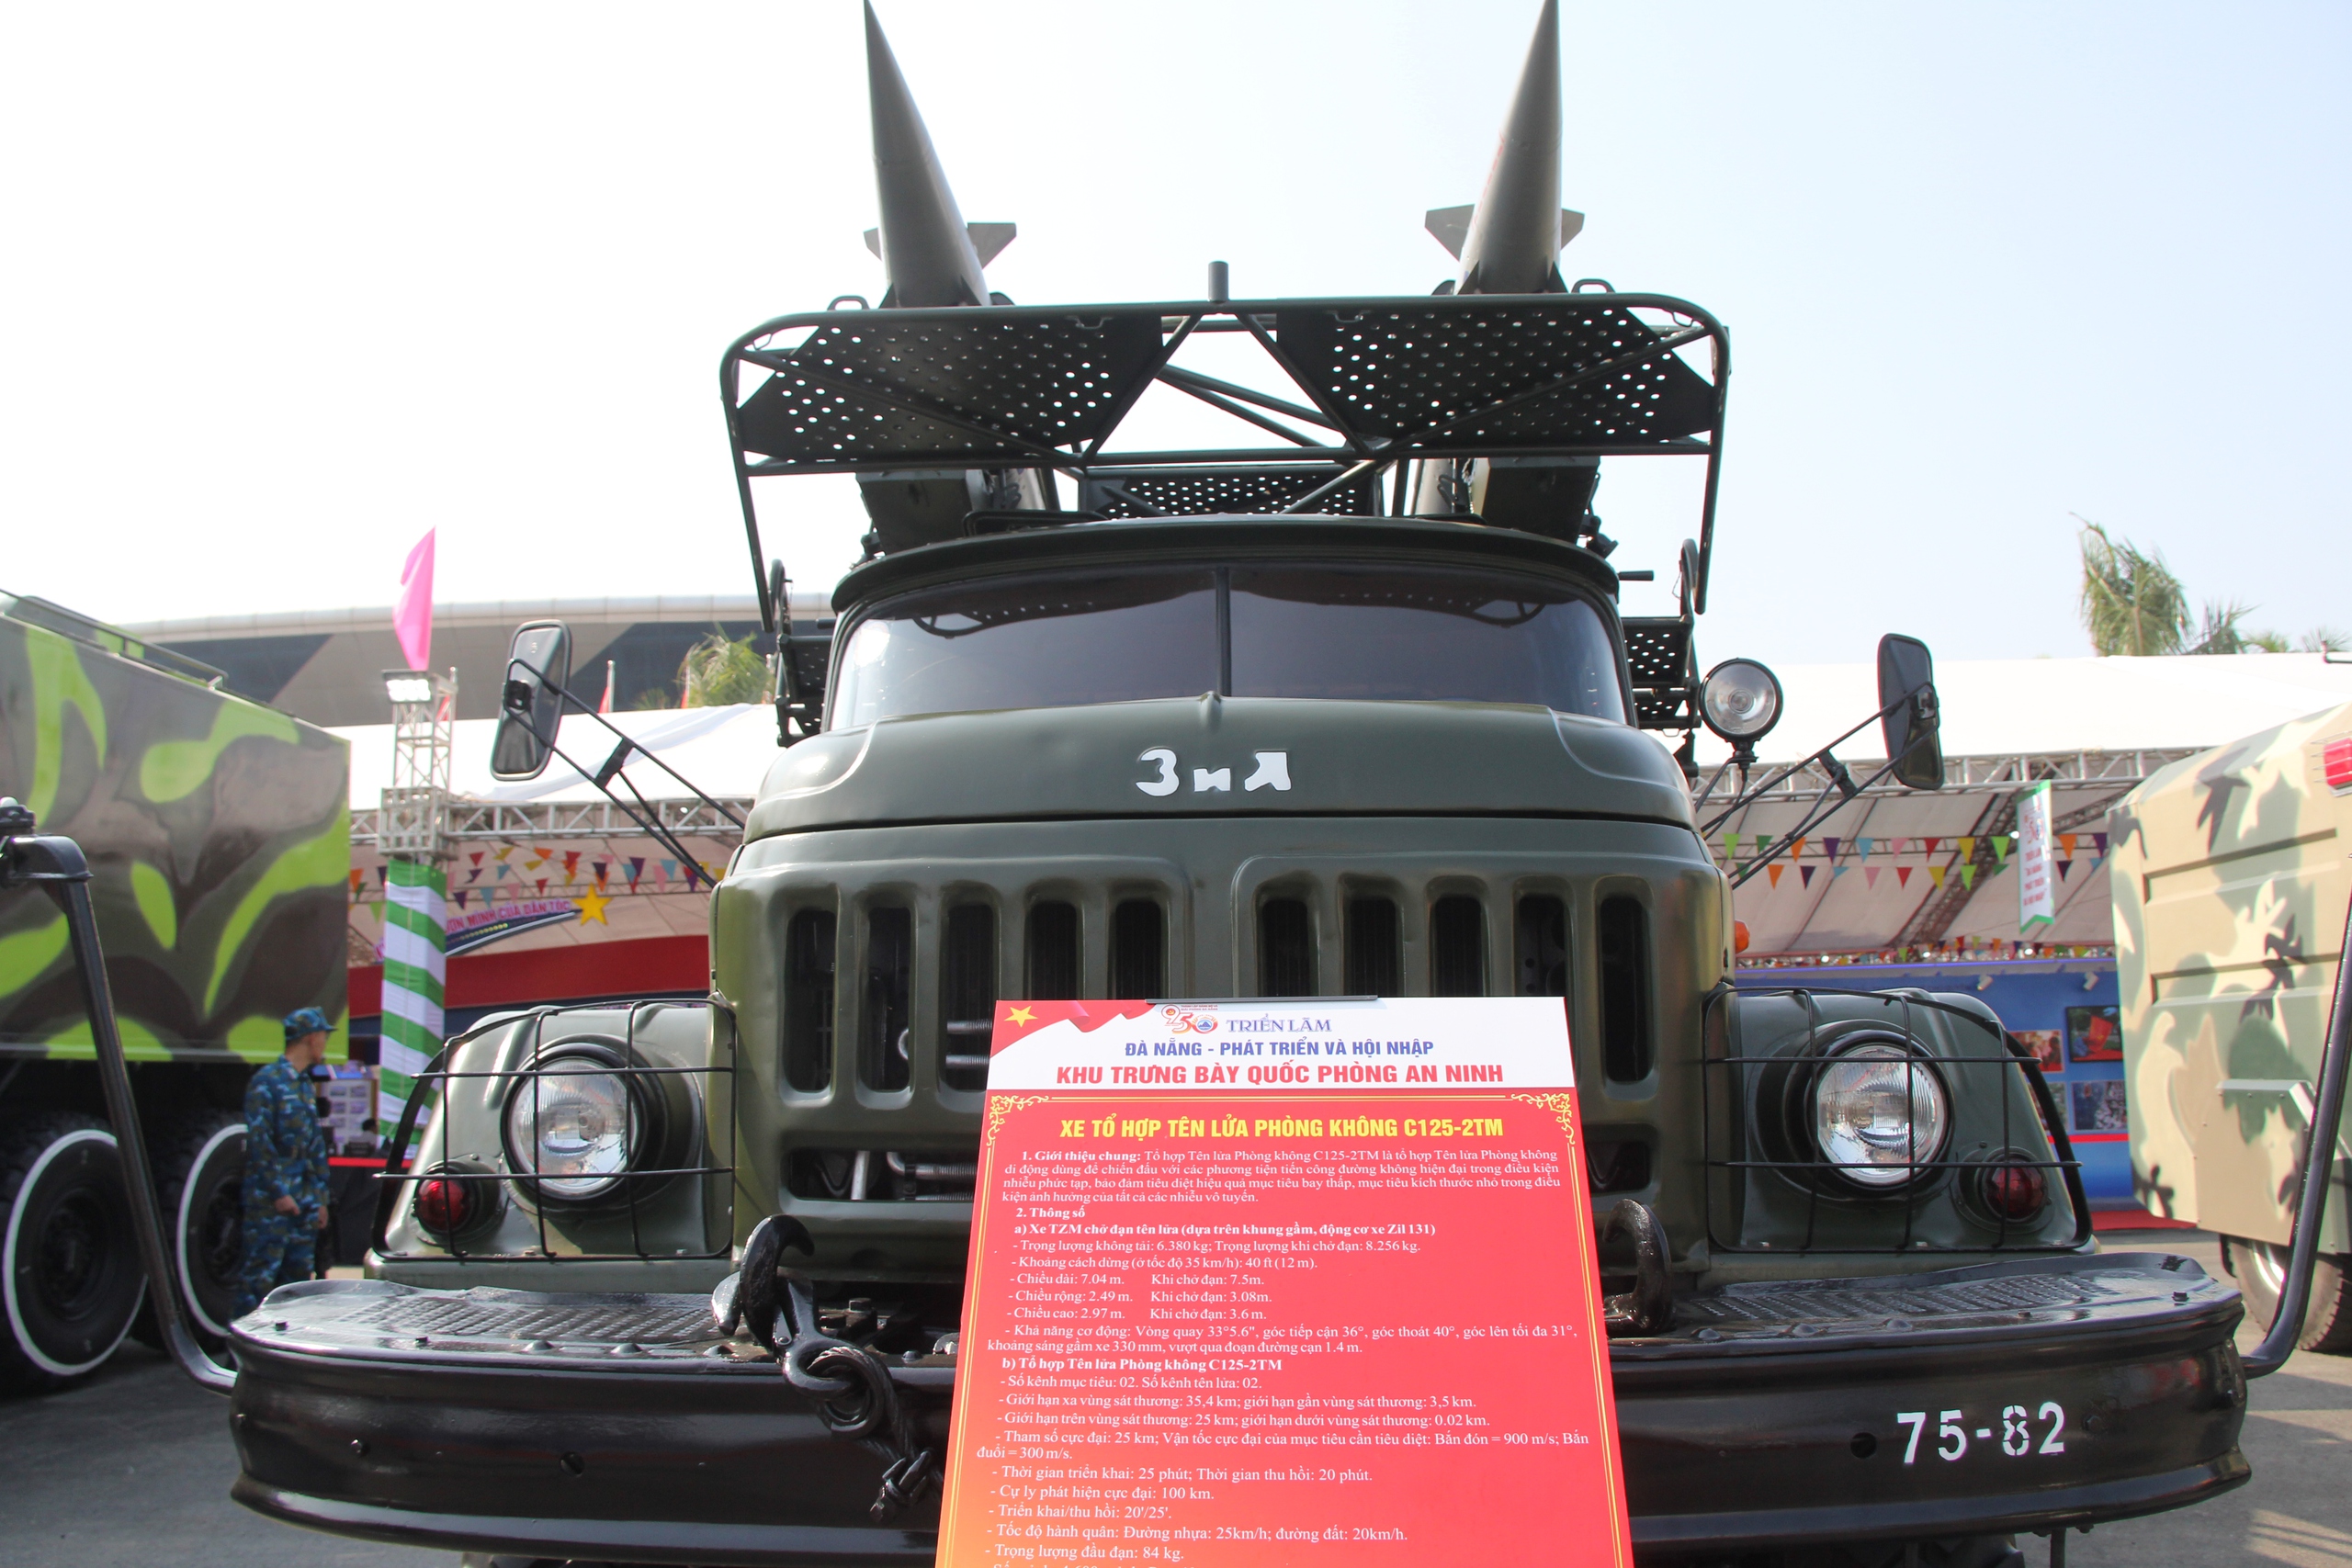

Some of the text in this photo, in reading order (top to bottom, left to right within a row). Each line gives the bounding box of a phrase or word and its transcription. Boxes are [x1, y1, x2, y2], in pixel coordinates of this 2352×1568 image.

[1226, 1013, 1332, 1032] TRIỂN LÃM
[1125, 1040, 1148, 1056] ĐÀ
[1153, 1036, 1203, 1056] NẴNG
[1220, 1039, 1264, 1056] PHÁT
[1269, 1036, 1319, 1055] TRIỂN
[1324, 1038, 1347, 1055] VÀ
[1351, 1038, 1381, 1058] HỘI
[1386, 1038, 1434, 1058] NHẬP
[1057, 1059, 1504, 1086] KHU TRƯNG BÀY QUỐC PHÒNG AN NINH
[1059, 1112, 1504, 1142] XE TỔ HỢP TÊN LỬA PHÒNG KHÔNG C125-2TM
[1023, 1147, 1558, 1163] 1. Giới thiệu chung: Tổ hợp Tên lửa Phòng không C125-2TM là tổ hợp Tên lửa Phòng không
[1016, 1204, 1086, 1220] 2. Thông số
[1014, 1221, 1436, 1237] a) Xe TZM chở đạn tên lửa (dựa trên khung gầm, động cơ xe Zil 131)
[1016, 1270, 1053, 1284] Chiều
[1055, 1273, 1078, 1284] dài:
[1080, 1273, 1107, 1284] 7.04
[1151, 1273, 1264, 1287] Khi chở đạn: 7.5m.
[1015, 1287, 1133, 1304] Chiều rộng: 2.49 m.
[1150, 1291, 1272, 1304] Khi chở đạn: 3.08m.
[1013, 1304, 1125, 1319] Chiều cao: 2.97 m.
[1150, 1308, 1267, 1321] Khi chở đạn: 3.6 m.
[1001, 1355, 1283, 1373] b) Tổ hợp Tên lửa Phòng không C125-2TM
[1008, 1372, 1262, 1389] Số kênh mục tiêu: 02. Số kênh tên lửa: 02.
[1896, 1402, 2066, 1465] 75-82
[976, 1443, 1005, 1459] đuổi
[1019, 1447, 1044, 1459] 300
[1046, 1448, 1073, 1460] m/s.
[1001, 1464, 1373, 1484] Thời gian triển khai: 25 phút; Thời gian thu hồi: 20 phút.
[1000, 1484, 1215, 1501] Cự ly phát hiện cực đại: 100 km.
[994, 1542, 1184, 1562] Trọng lượng đầu đạn: 84 kg.
